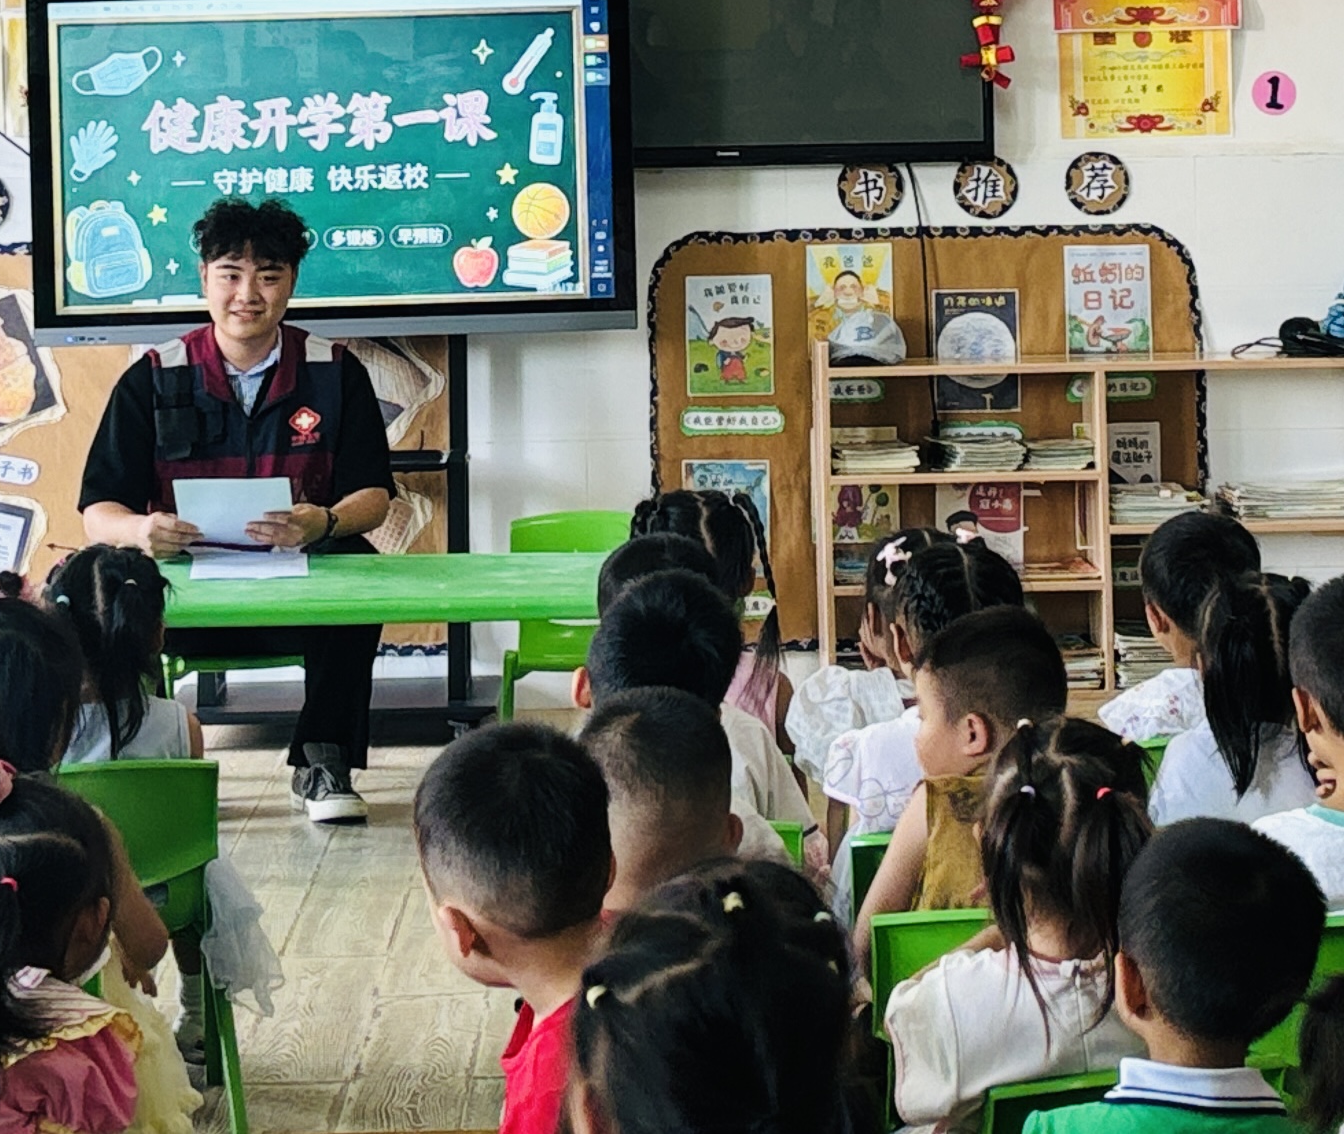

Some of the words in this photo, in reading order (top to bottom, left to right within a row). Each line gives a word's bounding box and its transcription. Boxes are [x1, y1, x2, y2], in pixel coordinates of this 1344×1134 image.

[1265, 76, 1284, 110] 1
[141, 90, 498, 154] 健康开学第一课
[213, 166, 314, 196] 守护健康
[327, 163, 430, 192] 快乐返校
[855, 171, 884, 207] 书
[968, 167, 1003, 206] 推
[1082, 163, 1116, 201] 荐
[331, 229, 378, 248] 多锻炼
[397, 226, 444, 245] 早预防
[823, 254, 874, 268] 我爸爸
[1071, 262, 1146, 284] 蚯蚓的
[1083, 287, 1135, 311] 日记
